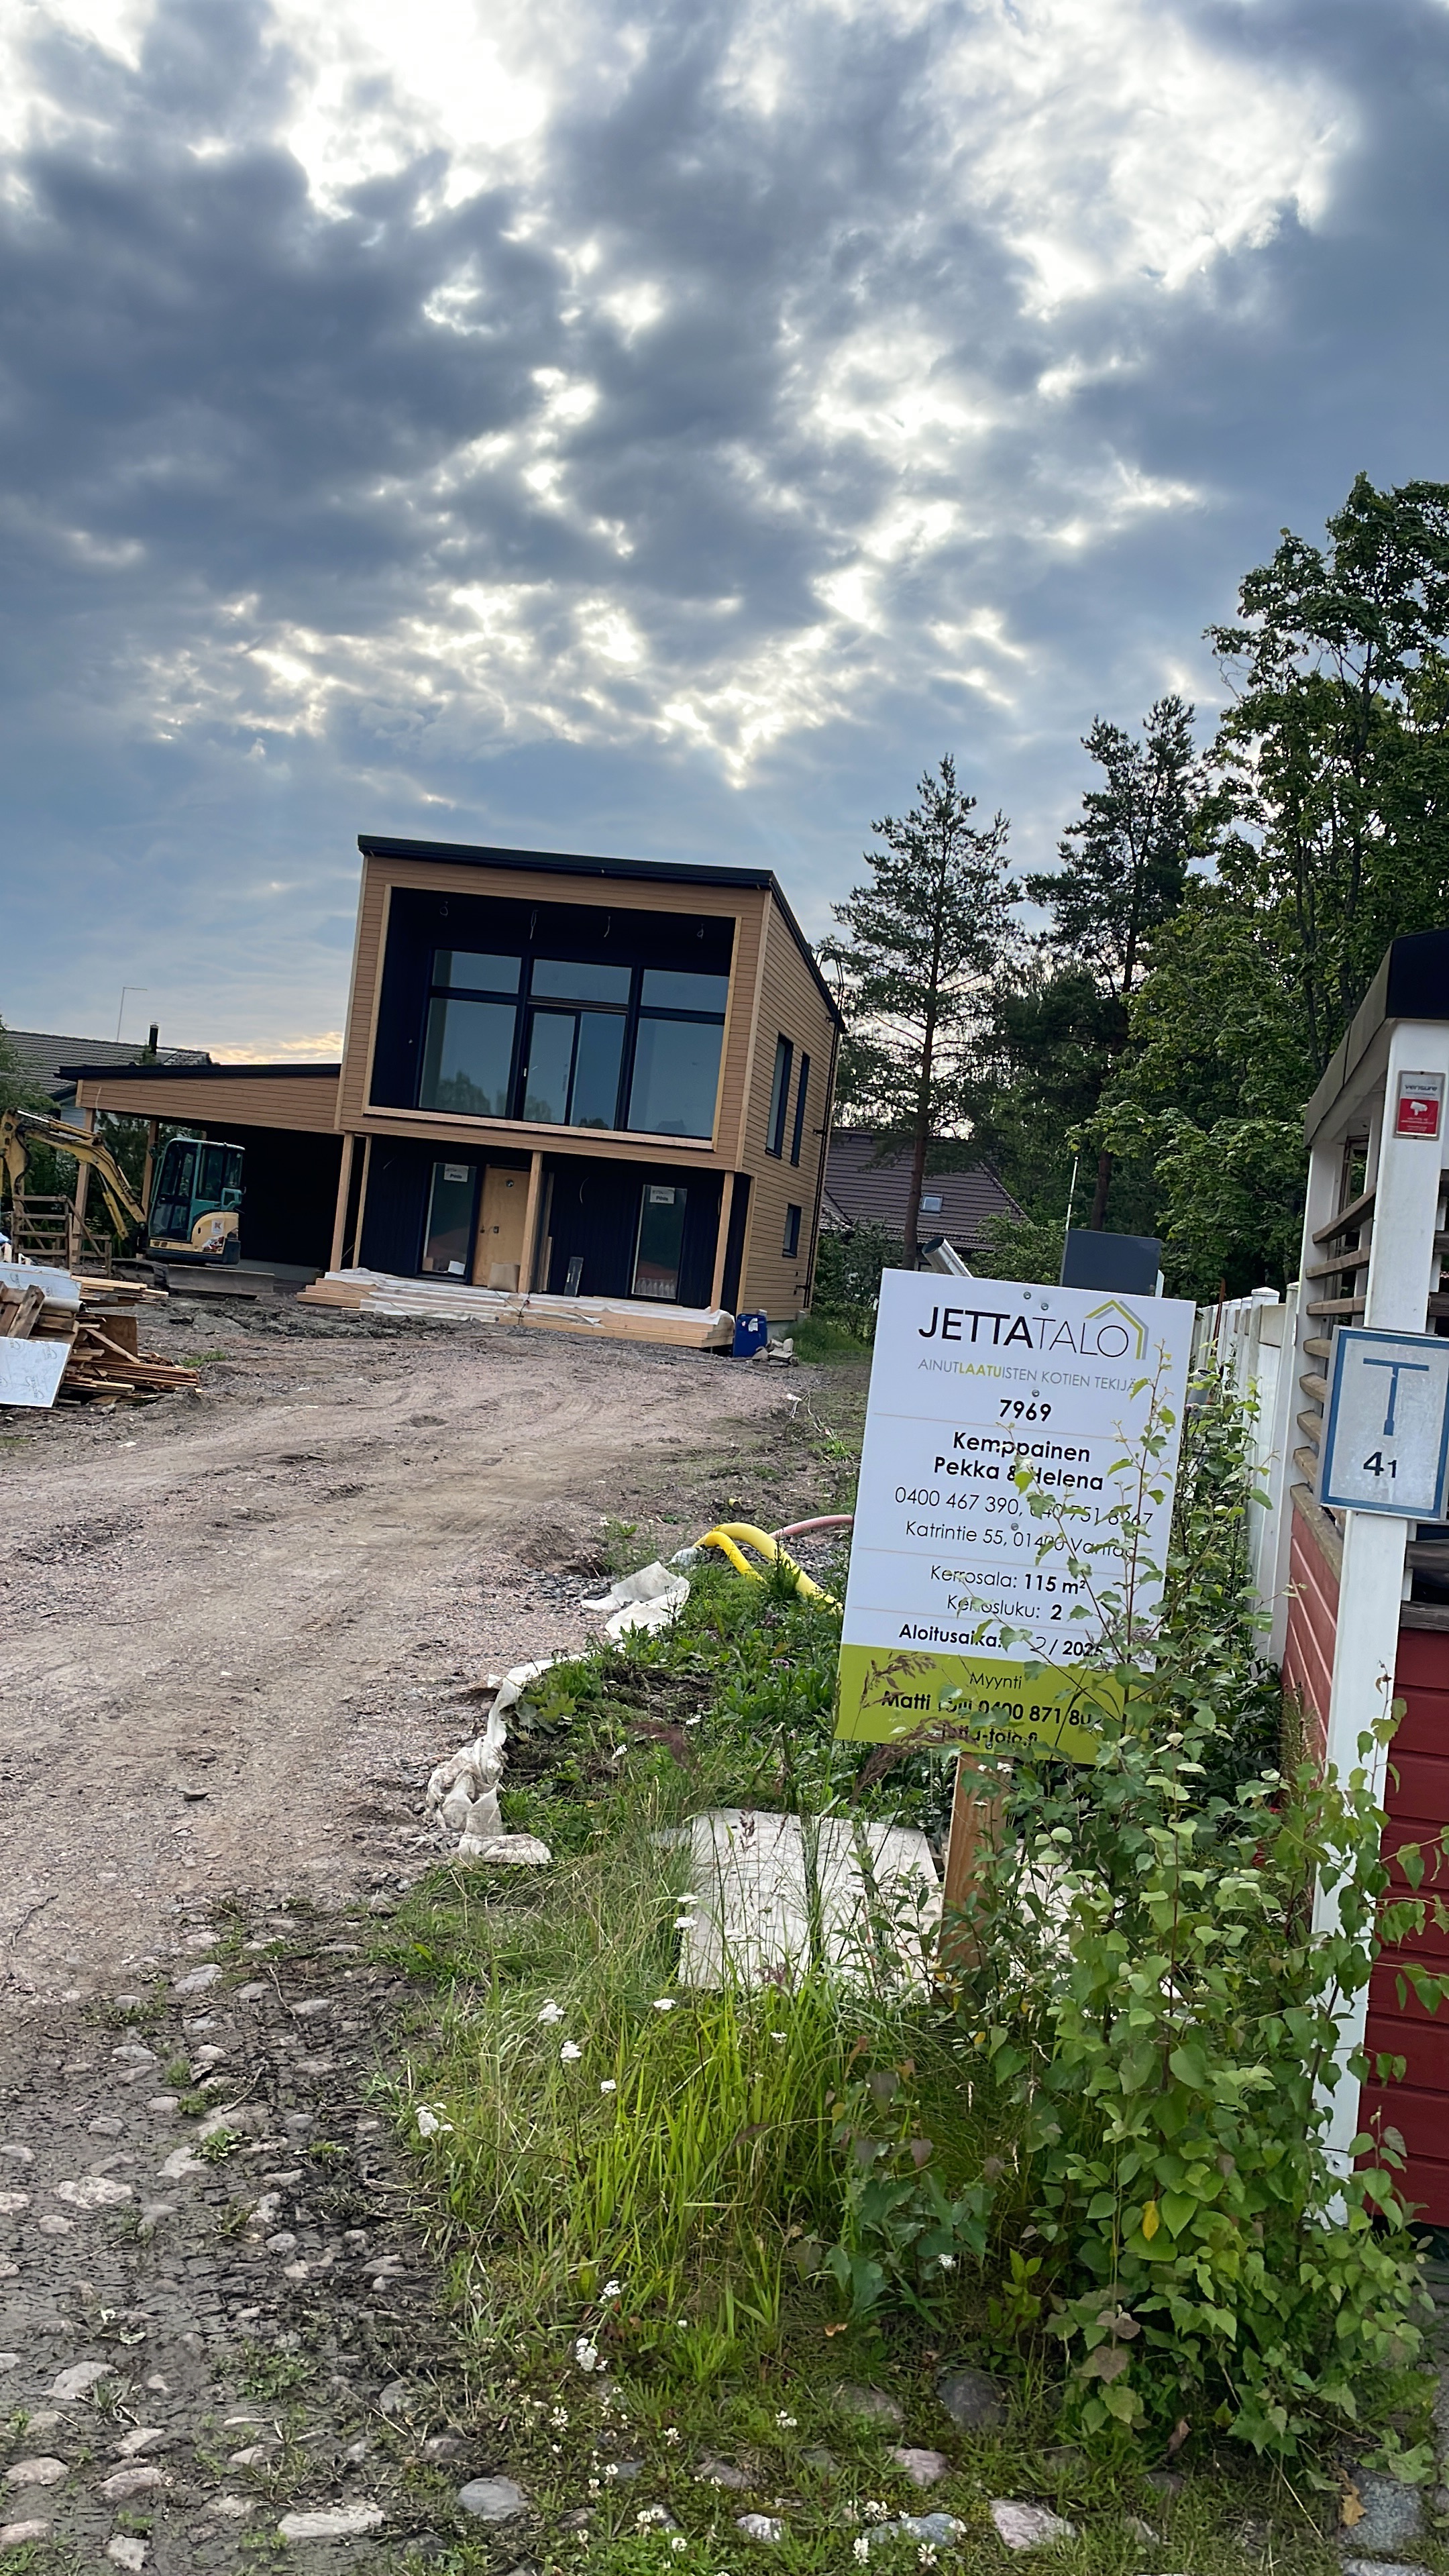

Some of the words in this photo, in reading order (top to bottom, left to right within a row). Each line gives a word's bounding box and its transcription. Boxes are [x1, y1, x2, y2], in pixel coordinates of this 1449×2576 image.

[918, 1306, 1129, 1358] JETTATALO
[918, 1358, 1038, 1381] AINUTLAATUISTEN
[1041, 1371, 1090, 1387] KOTIEN
[1000, 1399, 1052, 1422] 7969
[953, 1432, 1090, 1462] Kemppainen
[934, 1456, 1000, 1480] Pekka
[1030, 1466, 1104, 1491] Helena
[895, 1487, 940, 1507] 0400
[946, 1493, 980, 1510] 467
[985, 1496, 1023, 1517] 390,
[906, 1521, 977, 1542] Katrintie
[982, 1529, 1008, 1546] 55,
[1024, 1574, 1057, 1592] 115
[947, 1595, 1040, 1619] Kerosluku:
[1050, 1605, 1063, 1621] 2
[899, 1624, 1002, 1648] Aloitusaika:
[969, 1672, 1022, 1690] Myynti
[881, 1690, 931, 1711] Matti
[1029, 1705, 1061, 1725] 871
